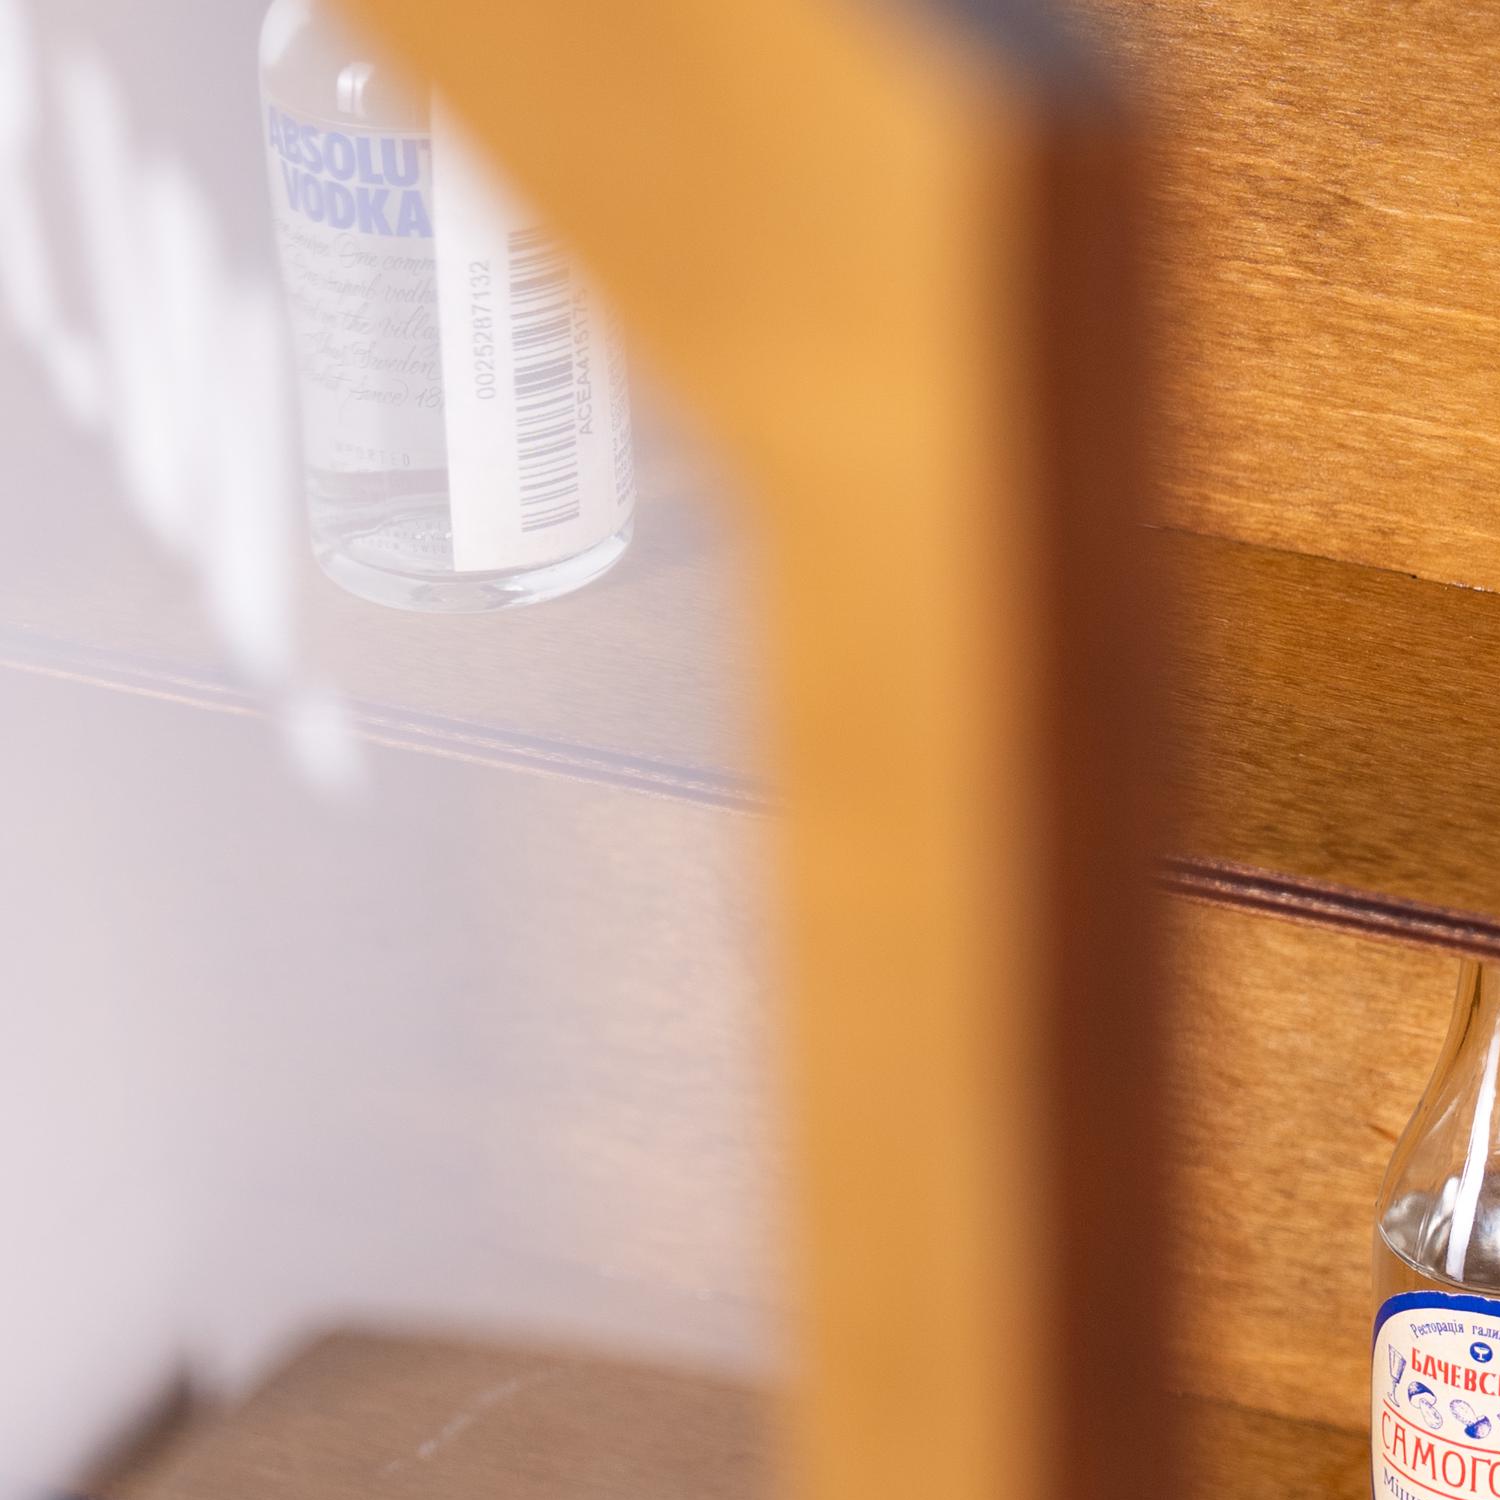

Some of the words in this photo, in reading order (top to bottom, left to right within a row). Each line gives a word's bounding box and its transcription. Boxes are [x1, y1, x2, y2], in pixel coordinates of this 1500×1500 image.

[281, 159, 433, 238] VODKA
[469, 259, 497, 400] 0025287132
[1410, 1319, 1465, 1338] Ресторація
